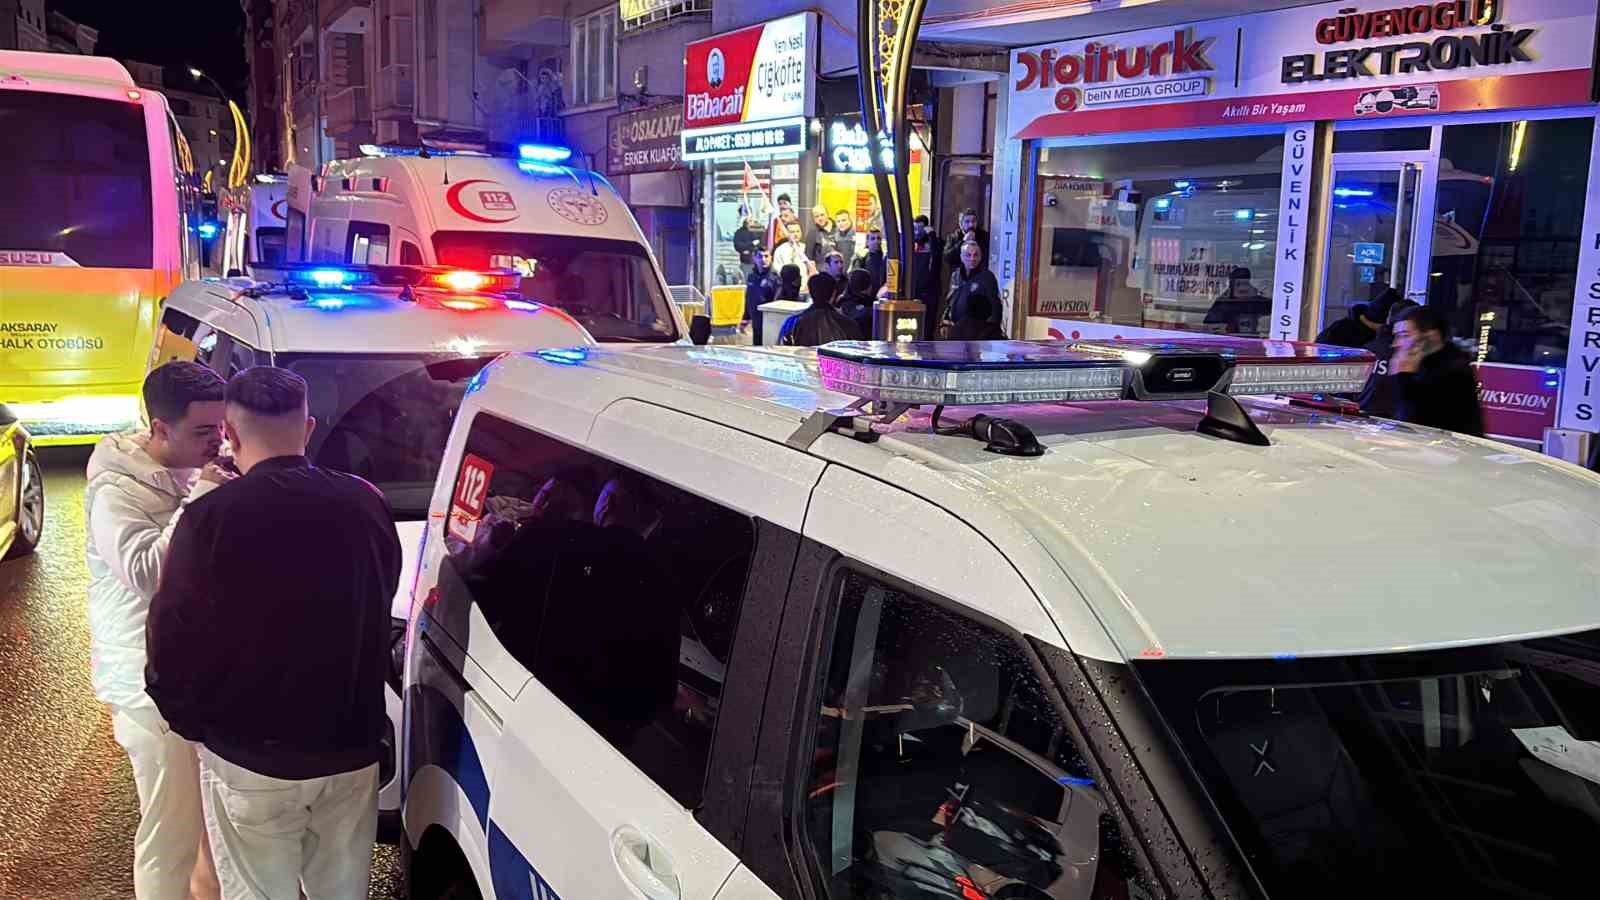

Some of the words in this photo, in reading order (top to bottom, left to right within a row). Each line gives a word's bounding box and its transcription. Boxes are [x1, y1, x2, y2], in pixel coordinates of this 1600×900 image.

[1281, 24, 1534, 83] ELEKTRONİK
[1087, 91, 1111, 101] beIN
[1114, 86, 1151, 98] MEDIA
[1154, 80, 1201, 95] GROUP
[1251, 104, 1268, 115] Bir
[1271, 103, 1306, 116] Yaşam
[624, 150, 649, 166] ERKEK
[484, 192, 509, 202] 112
[1284, 129, 1307, 261] GÜVENLİK
[1041, 301, 1091, 313] HIKVISION
[1, 323, 58, 332] AKSARAY
[37, 336, 104, 350] OTOBÜSÜ
[460, 465, 486, 510] 112
